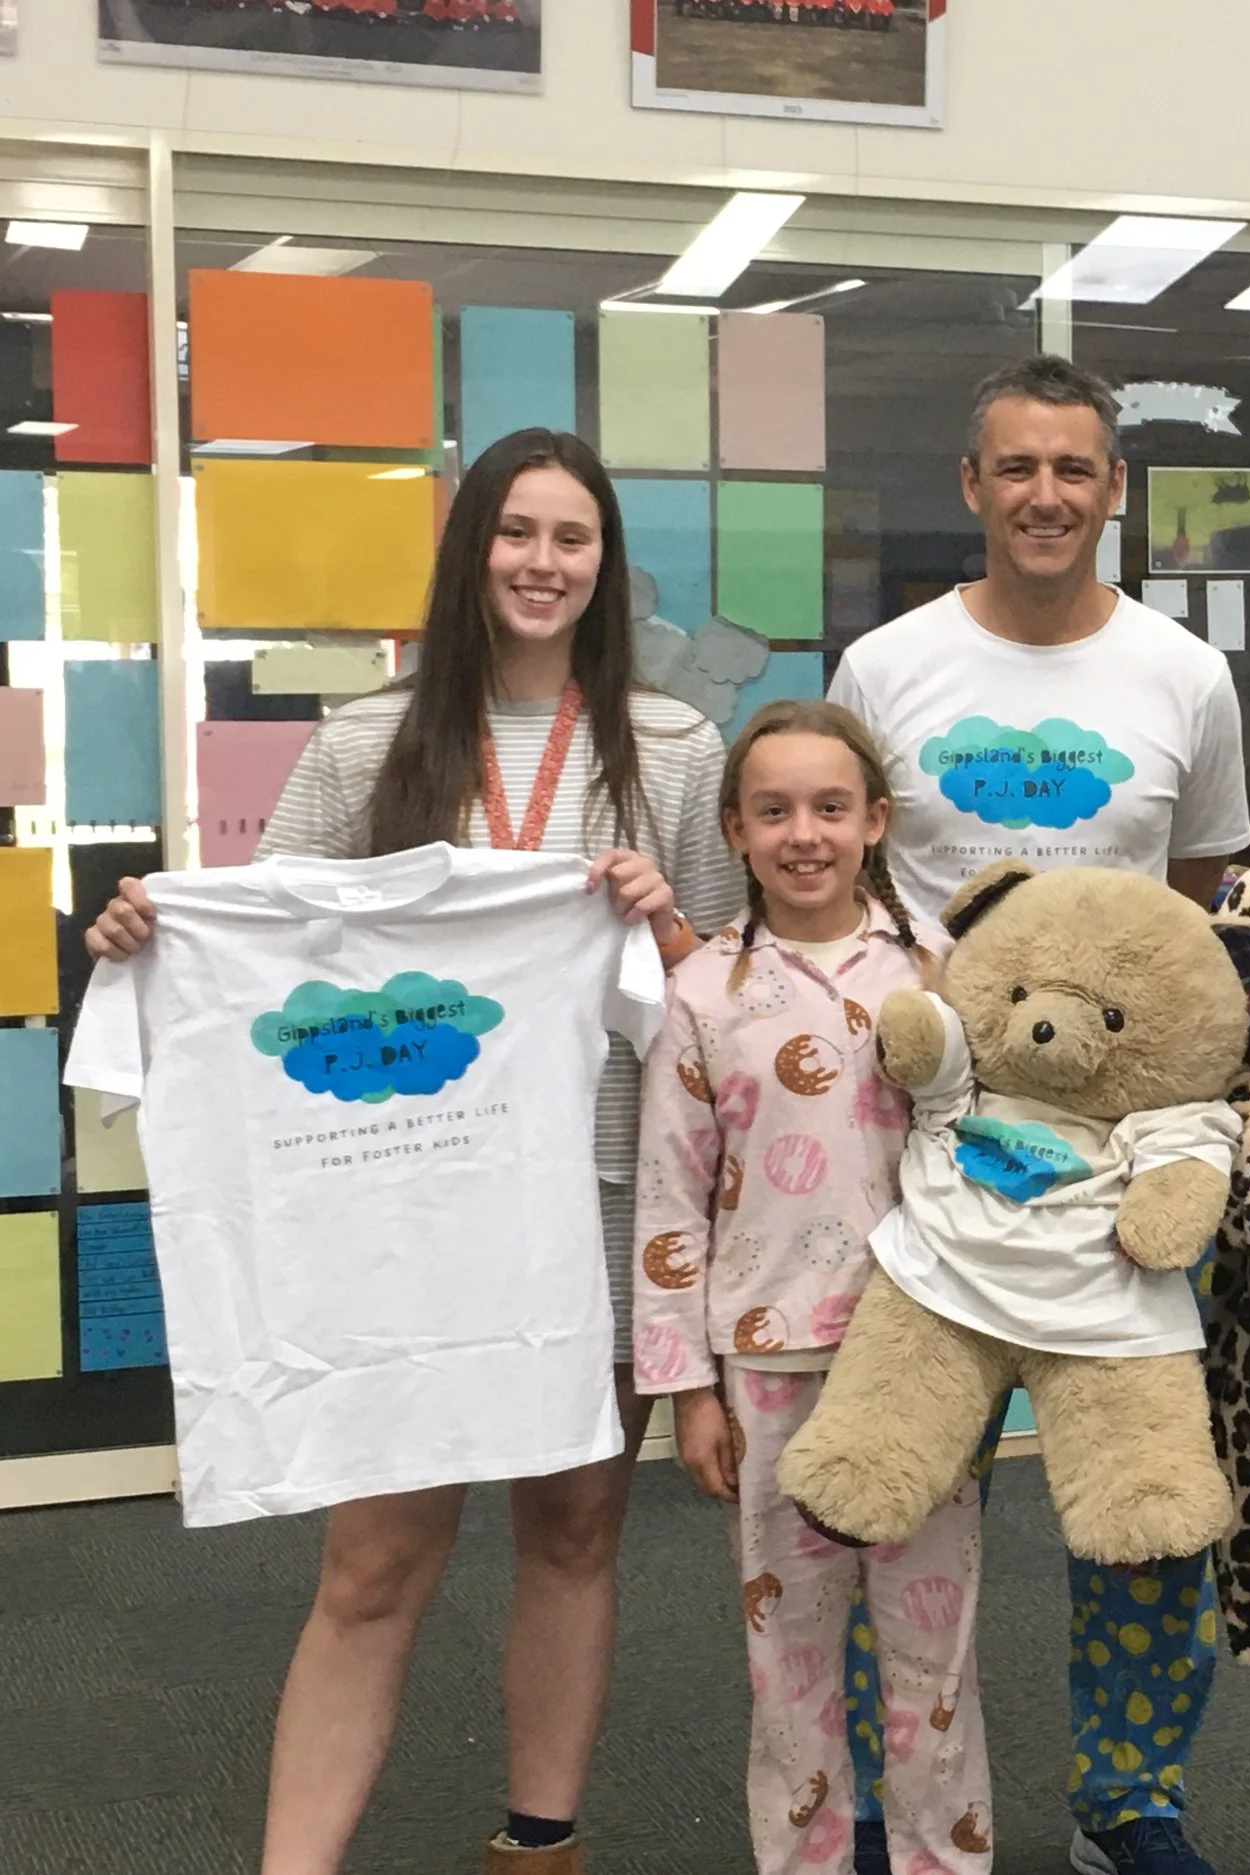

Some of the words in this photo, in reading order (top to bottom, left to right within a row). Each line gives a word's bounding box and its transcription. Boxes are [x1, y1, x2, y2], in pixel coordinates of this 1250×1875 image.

[938, 747, 1035, 769] Gippsland's
[1041, 749, 1104, 771] Biggest
[973, 779, 1015, 798] P.J.
[1024, 779, 1067, 798] DAY
[931, 844, 1013, 857] SUPPORTING
[1020, 846, 1029, 857] A
[1037, 846, 1088, 857] BETTER
[1094, 844, 1120, 856] LIFE
[960, 867, 977, 878] FO
[278, 1010, 389, 1046] Gippsland's
[395, 999, 467, 1031] Biggest
[324, 1053, 373, 1076] P.J.
[380, 1039, 429, 1066] DAY
[273, 1124, 380, 1150] SUPPORTING
[388, 1121, 397, 1132] A
[406, 1110, 466, 1128] BETTER
[475, 1103, 510, 1118] LIFE
[321, 1155, 353, 1169] FOR
[362, 1143, 423, 1162] FOSTER
[433, 1135, 471, 1150] KIDS
[1015, 1139, 1069, 1163] Biggest
